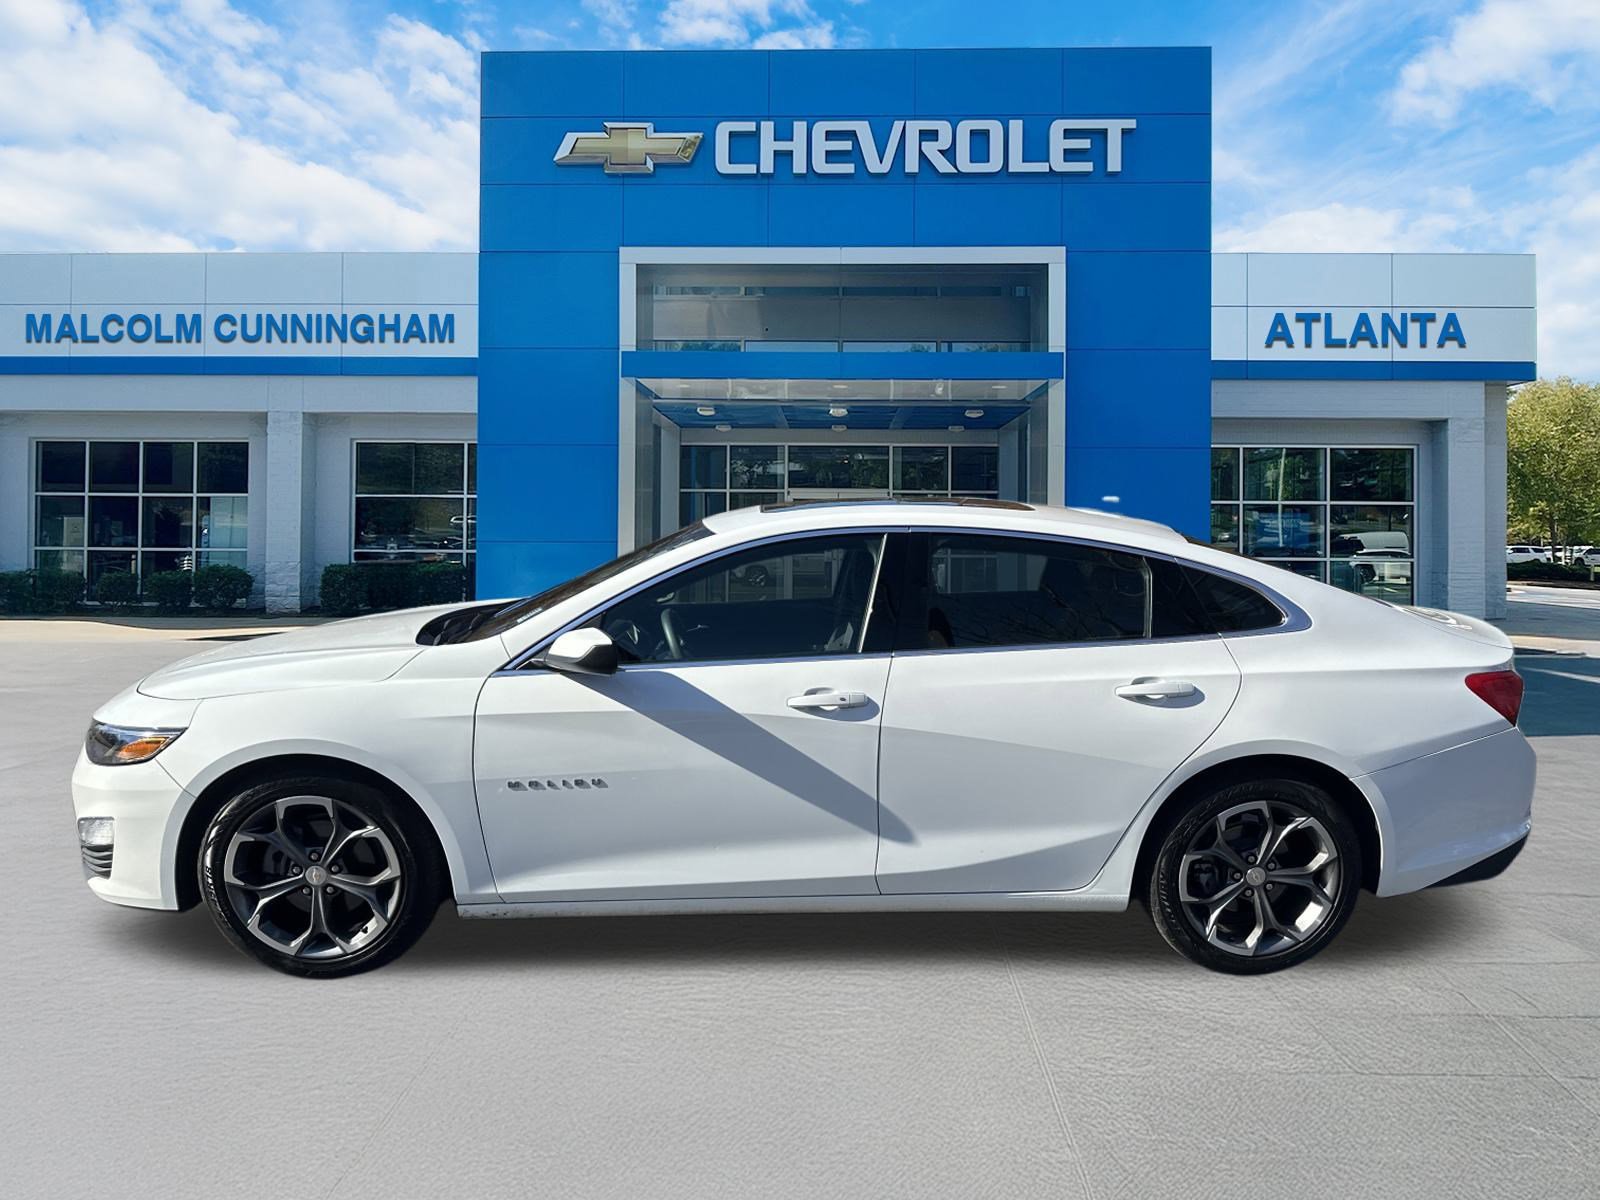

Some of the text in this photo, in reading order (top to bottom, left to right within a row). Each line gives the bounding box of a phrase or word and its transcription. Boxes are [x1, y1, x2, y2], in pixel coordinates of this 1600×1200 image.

[714, 118, 1137, 175] CHEVROLET
[26, 313, 455, 344] MALCOLM CUNNINGHAM
[1265, 312, 1467, 348] ATLANTA
